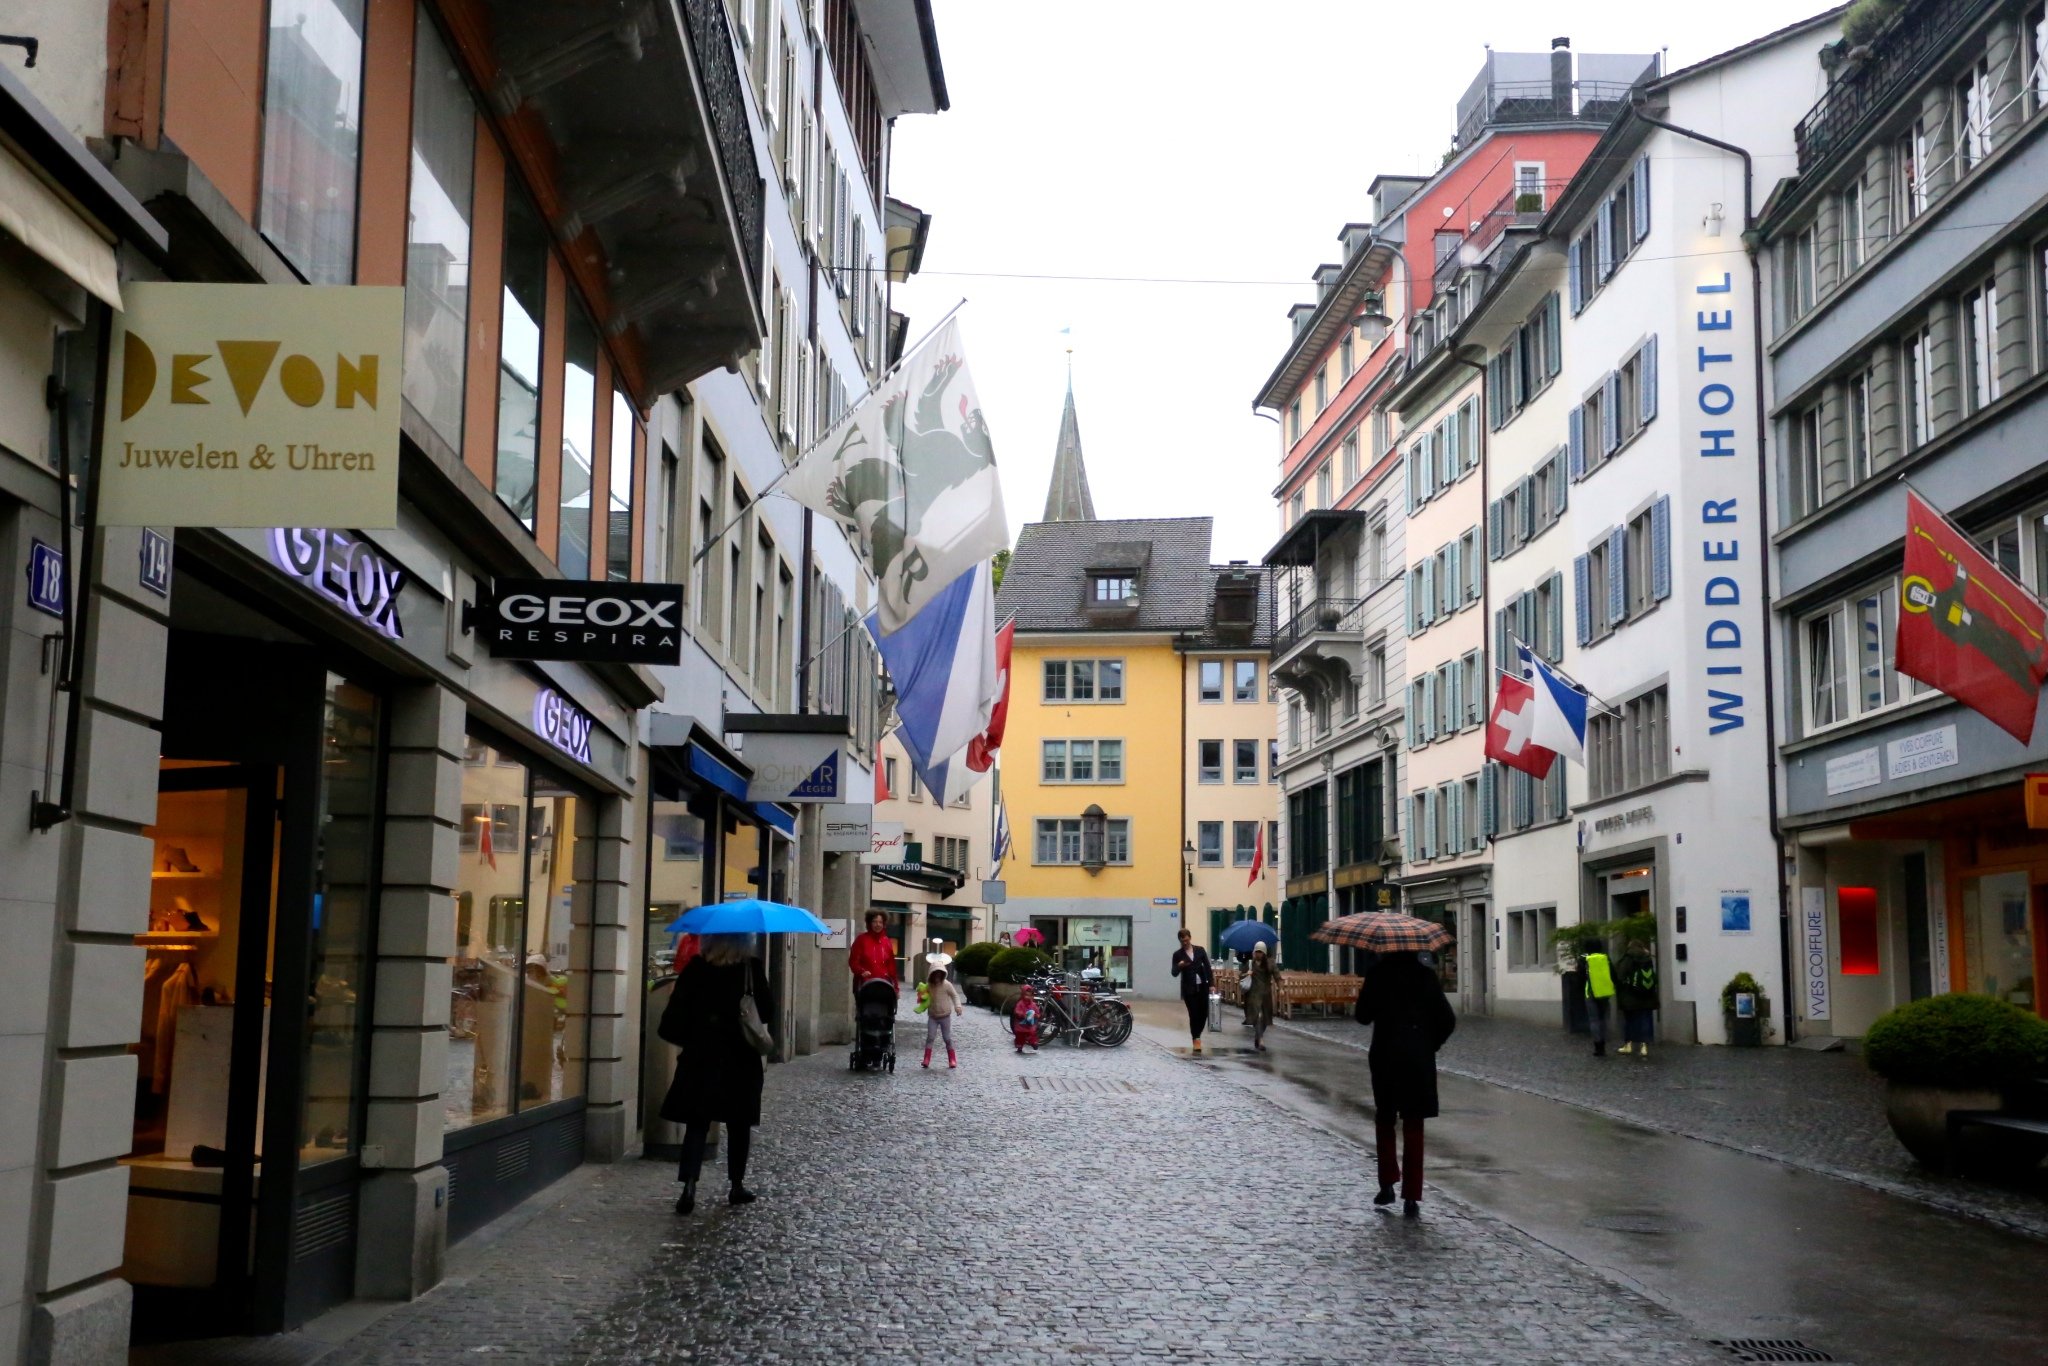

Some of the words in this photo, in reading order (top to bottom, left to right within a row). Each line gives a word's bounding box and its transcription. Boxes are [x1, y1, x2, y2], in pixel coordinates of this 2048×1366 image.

[121, 330, 379, 422] DEVON
[1697, 272, 1735, 457] HOTEL
[119, 442, 239, 468] Juwelen
[248, 443, 276, 469] &
[286, 444, 375, 471] Uhren
[40, 555, 61, 603] 18
[148, 537, 166, 584] 14
[276, 528, 407, 638] GEOX
[499, 594, 676, 628] GEOX
[1702, 498, 1744, 735] WIDDER
[499, 629, 674, 647] RESPIRA
[540, 688, 593, 763] GEOX
[754, 764, 812, 783] JOHN
[820, 765, 833, 783] R
[826, 823, 868, 831] SAM
[879, 863, 920, 871] MEPHISTO
[1808, 911, 1824, 978] COIFFURE
[1811, 981, 1825, 1016] YVES
